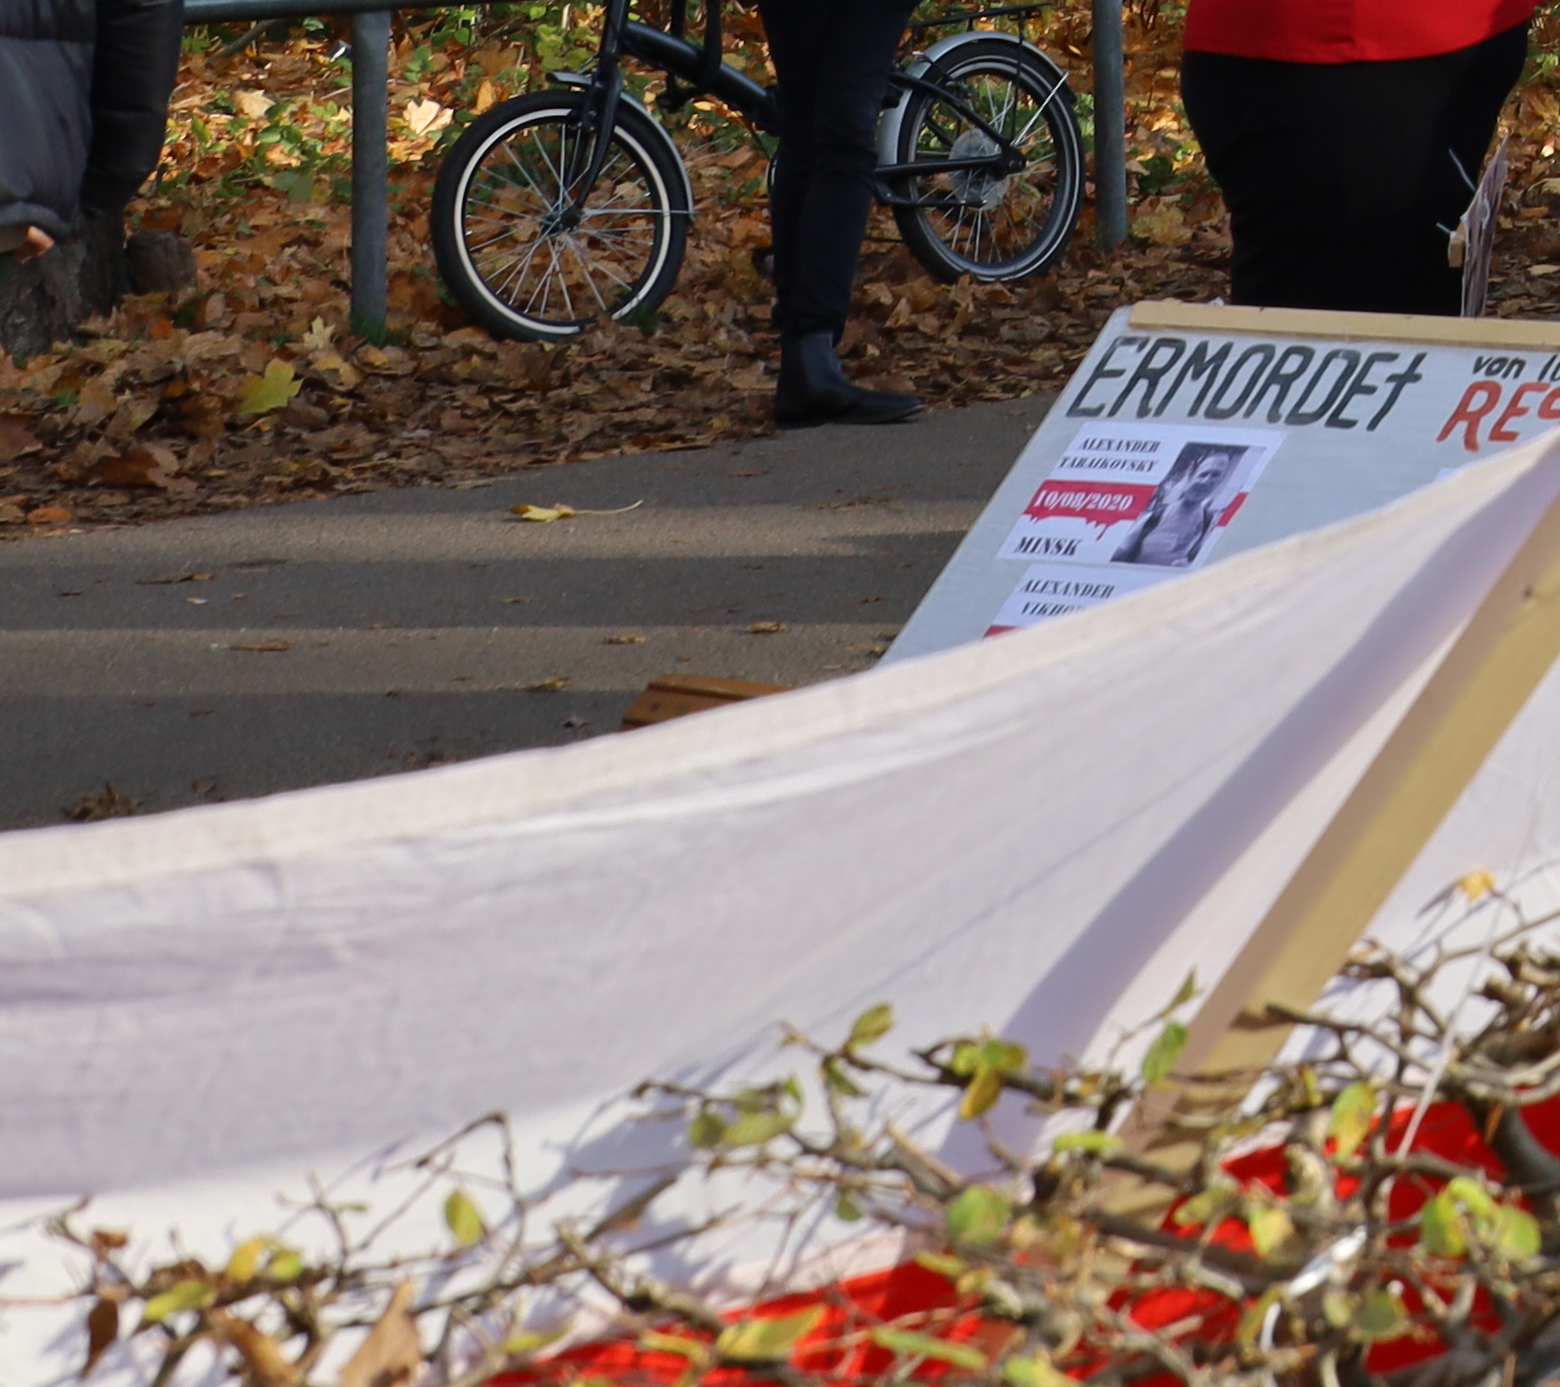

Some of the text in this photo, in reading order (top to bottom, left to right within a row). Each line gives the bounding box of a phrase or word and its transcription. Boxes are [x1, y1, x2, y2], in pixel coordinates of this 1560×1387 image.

[1472, 353, 1527, 380] von
[1077, 437, 1161, 454] ALEXANDER
[1057, 456, 1159, 473] TARAIKOVSKY
[1032, 488, 1134, 513] 10/08/2020
[1013, 535, 1083, 557] MINSK
[1020, 579, 1116, 599] ALEXANDER
